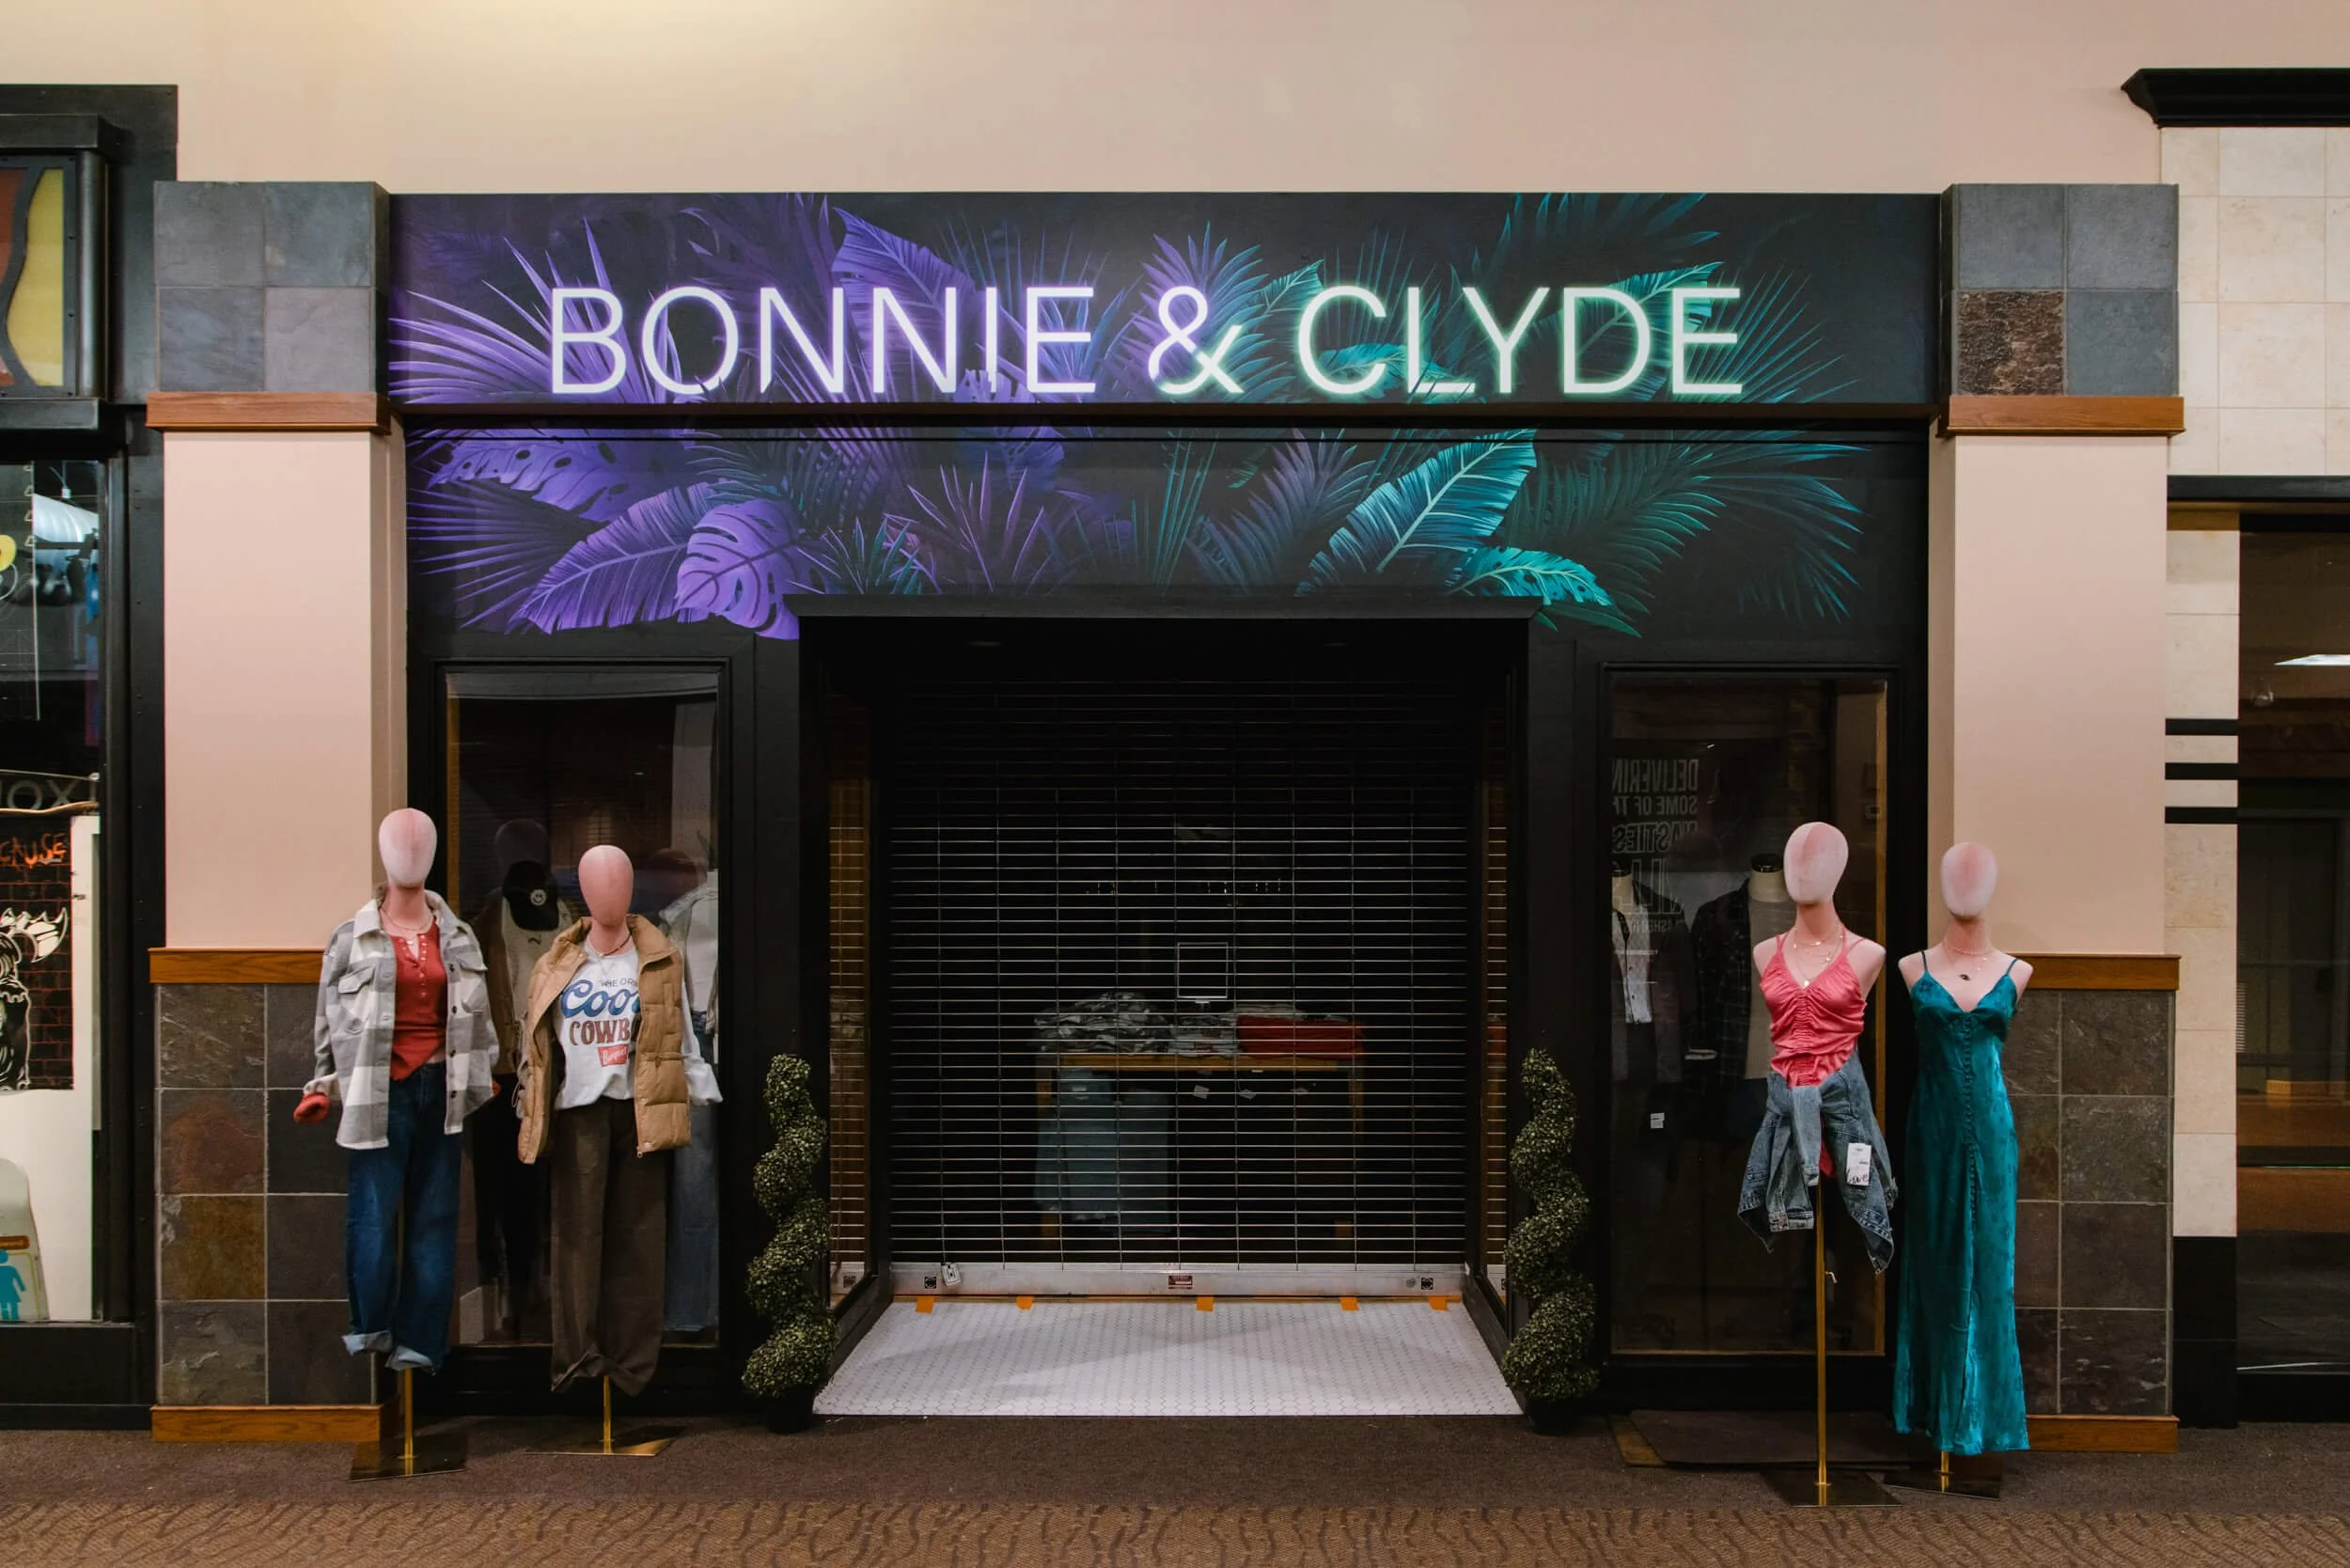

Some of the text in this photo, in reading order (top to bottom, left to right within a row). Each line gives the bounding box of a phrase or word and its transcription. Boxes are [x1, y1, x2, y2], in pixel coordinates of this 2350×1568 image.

[550, 285, 1743, 395] BONNIE & CLYDE
